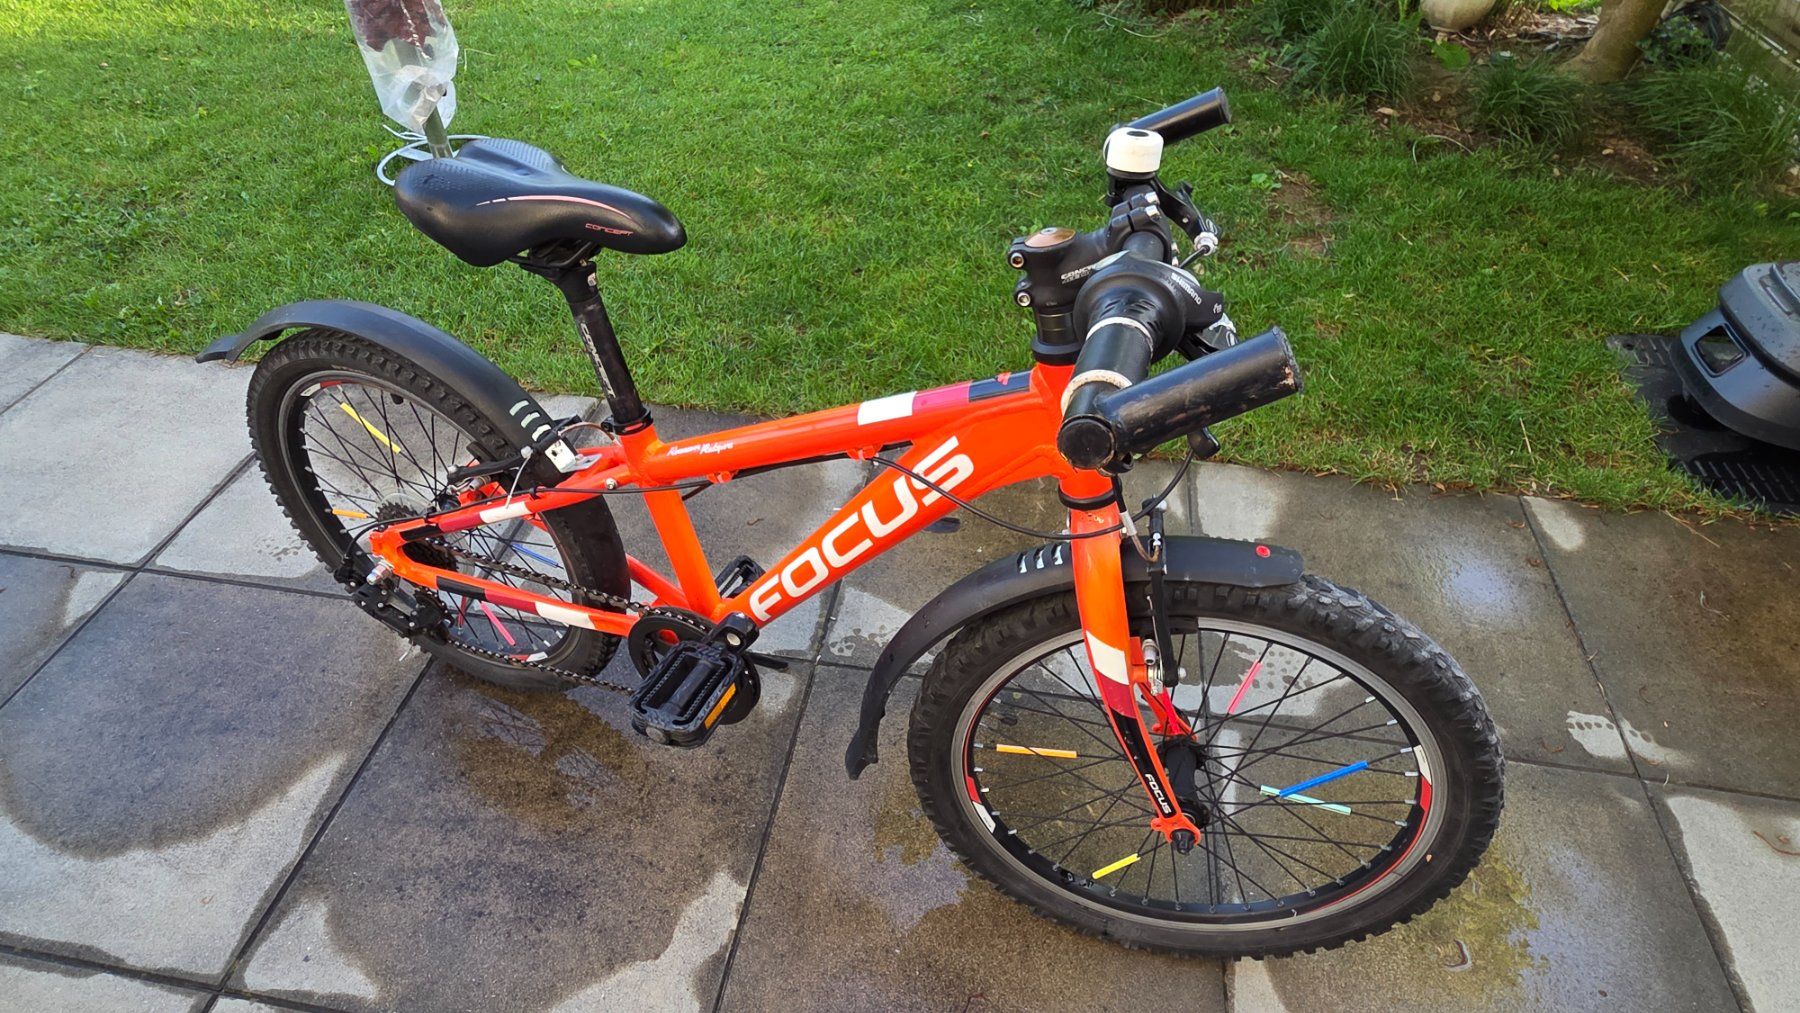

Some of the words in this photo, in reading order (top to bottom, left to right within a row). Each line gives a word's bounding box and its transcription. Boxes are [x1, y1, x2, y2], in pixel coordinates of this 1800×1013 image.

[584, 223, 634, 236] CONCEPT
[1170, 272, 1202, 305] SHIMANO
[749, 435, 975, 622] FOCUS
[1144, 773, 1172, 814] FOCUS
